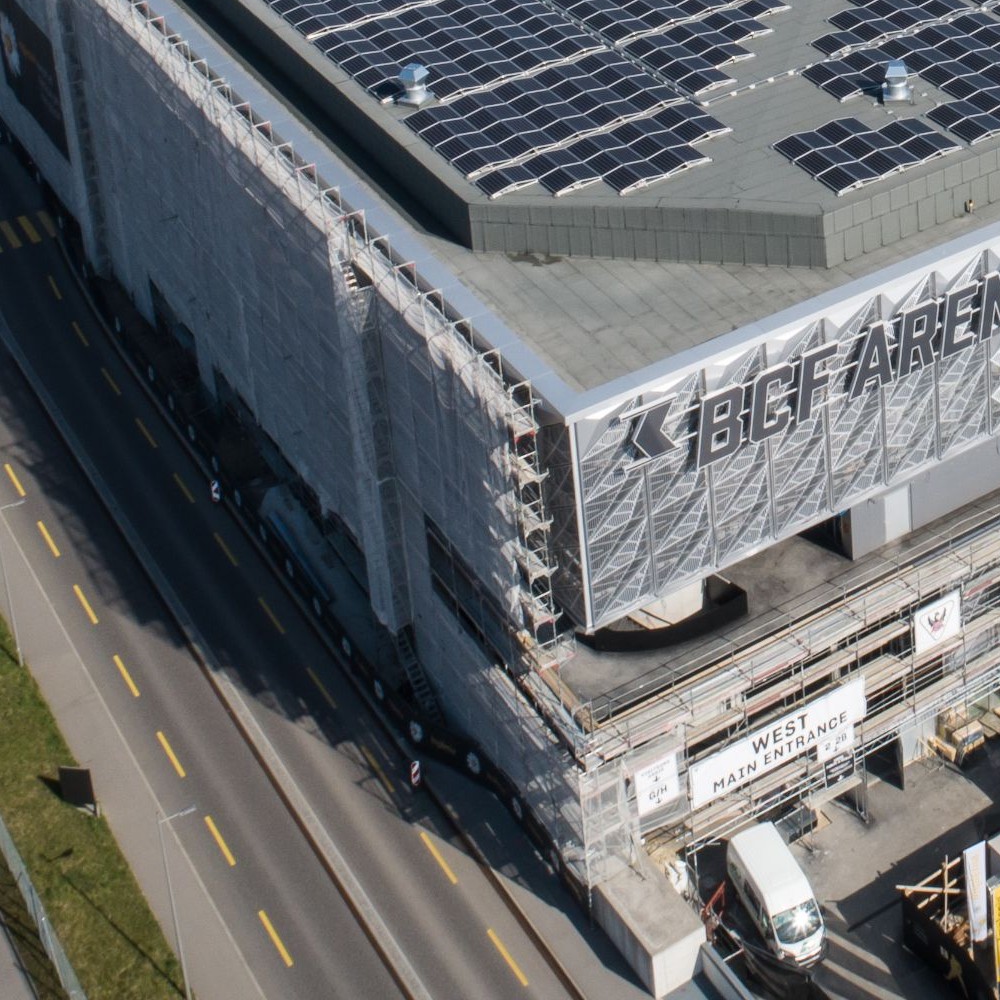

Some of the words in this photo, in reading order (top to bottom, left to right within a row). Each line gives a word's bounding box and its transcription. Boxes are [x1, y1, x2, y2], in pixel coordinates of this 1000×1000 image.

[699, 344, 838, 468] BCF
[713, 760, 757, 793] MAIN
[764, 711, 848, 766] ENTRANCE
[752, 713, 809, 754] WEST
